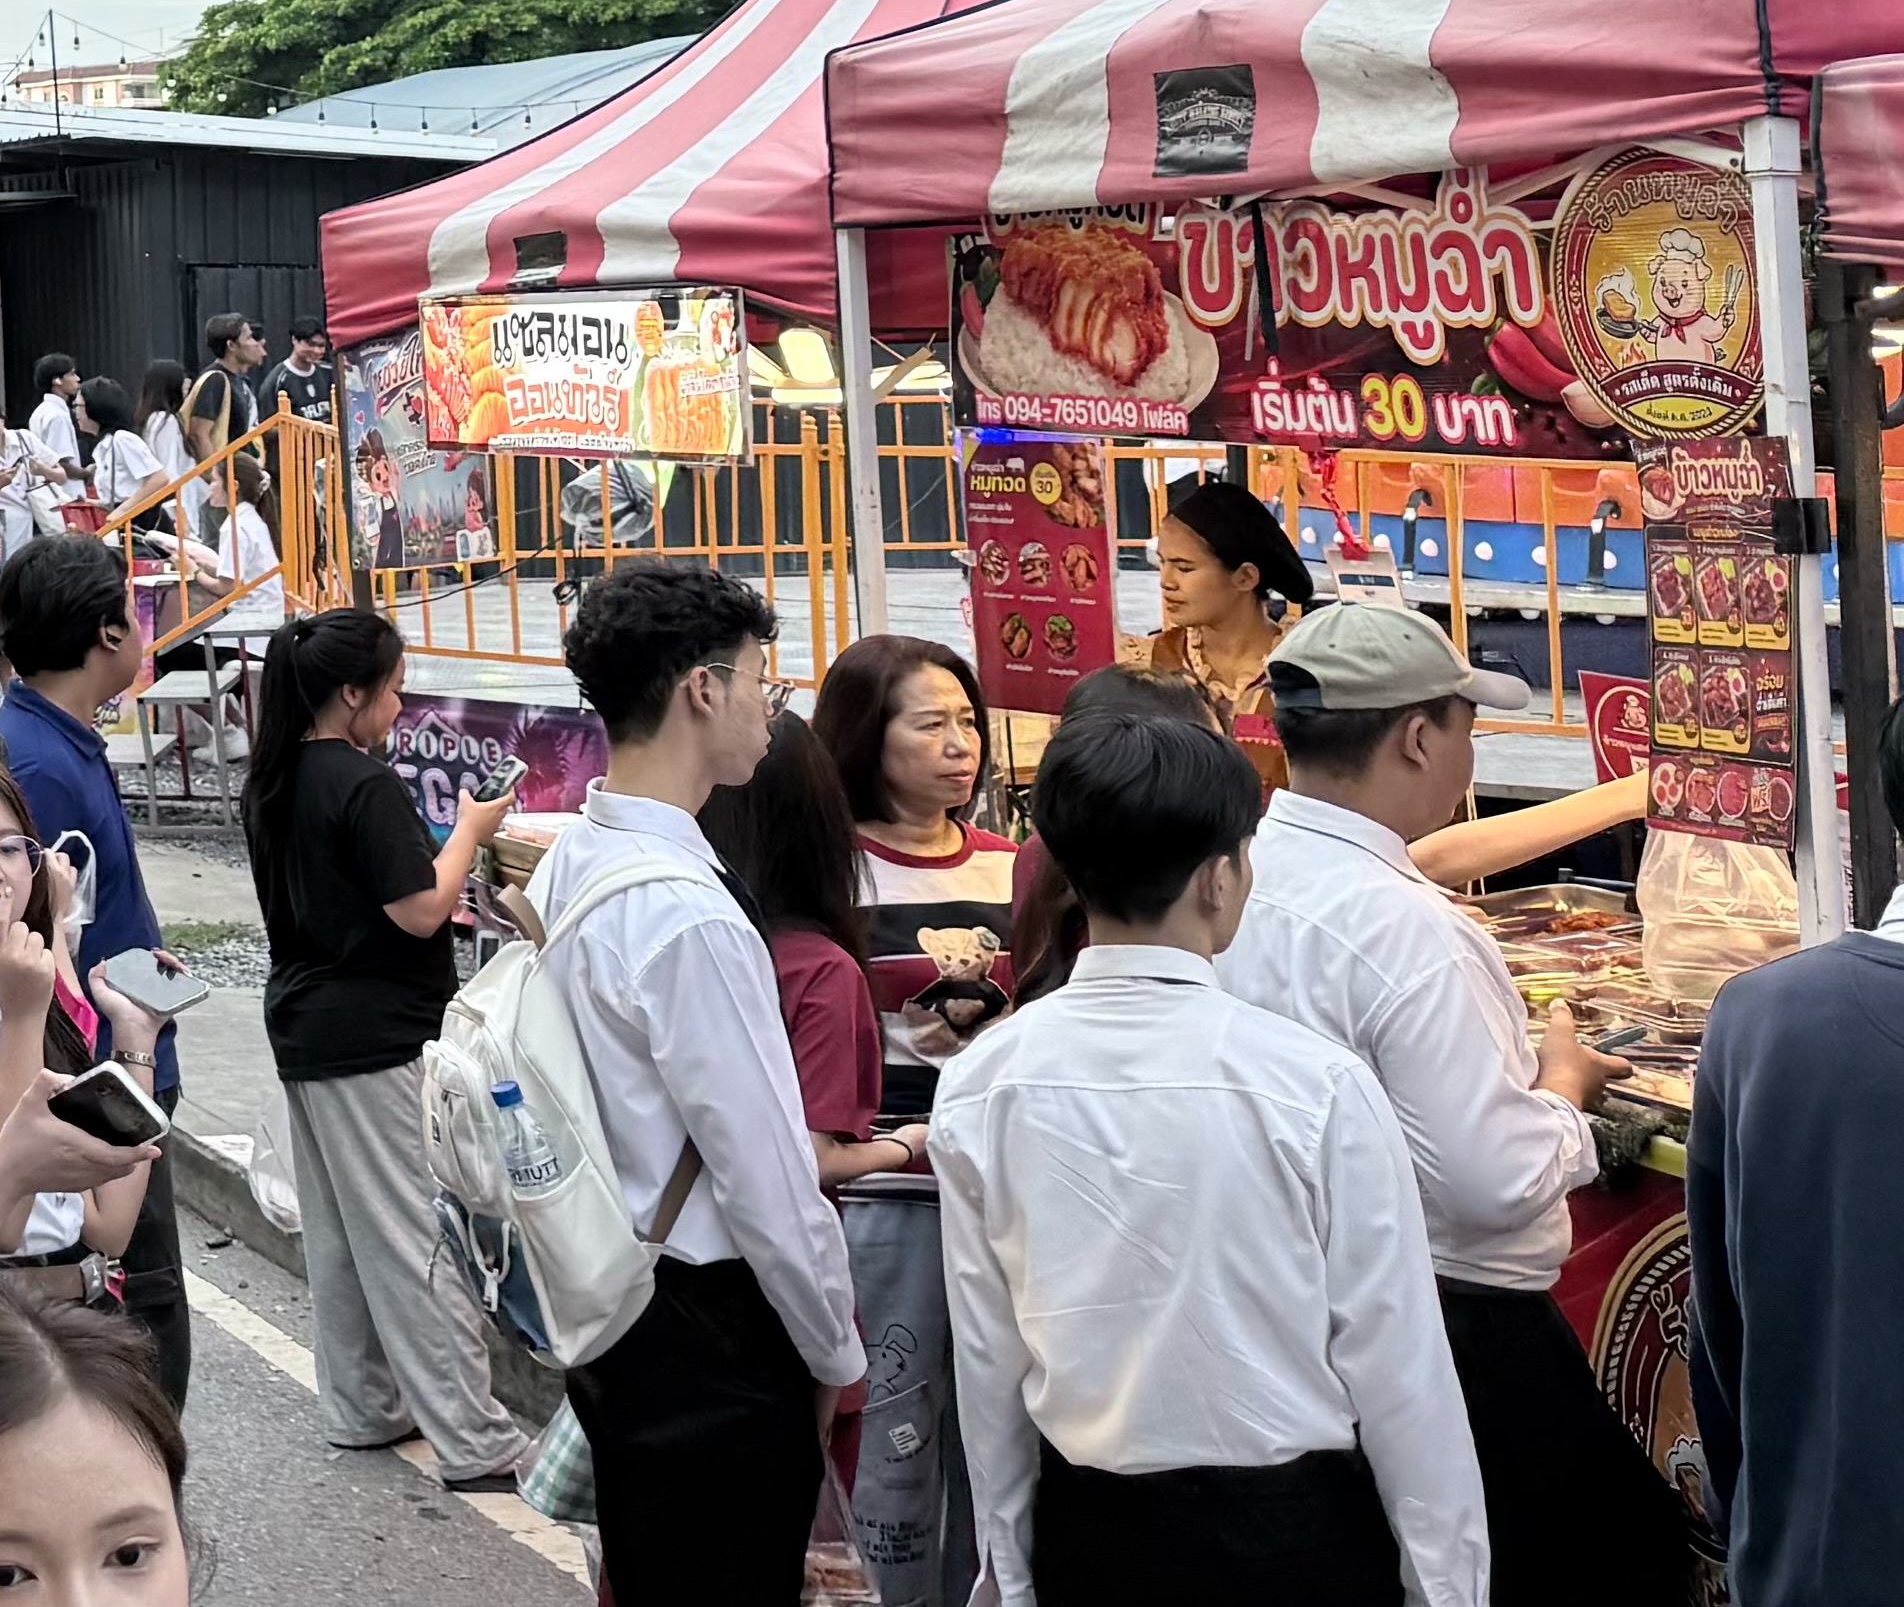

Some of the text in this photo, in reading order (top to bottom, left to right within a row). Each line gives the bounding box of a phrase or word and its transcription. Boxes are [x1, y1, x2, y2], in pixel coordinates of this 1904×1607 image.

[1180, 168, 1539, 358] ขาวหมูฉ่ำ
[491, 308, 631, 366] แซลมอน
[504, 363, 624, 428] ออนทัวร์
[976, 394, 1002, 421] โทร
[1251, 357, 1516, 445] เริ่มต้น 30 บาท
[970, 475, 1026, 499] หมูทอด
[1035, 480, 1054, 495] 30
[397, 730, 500, 764] RIPLE
